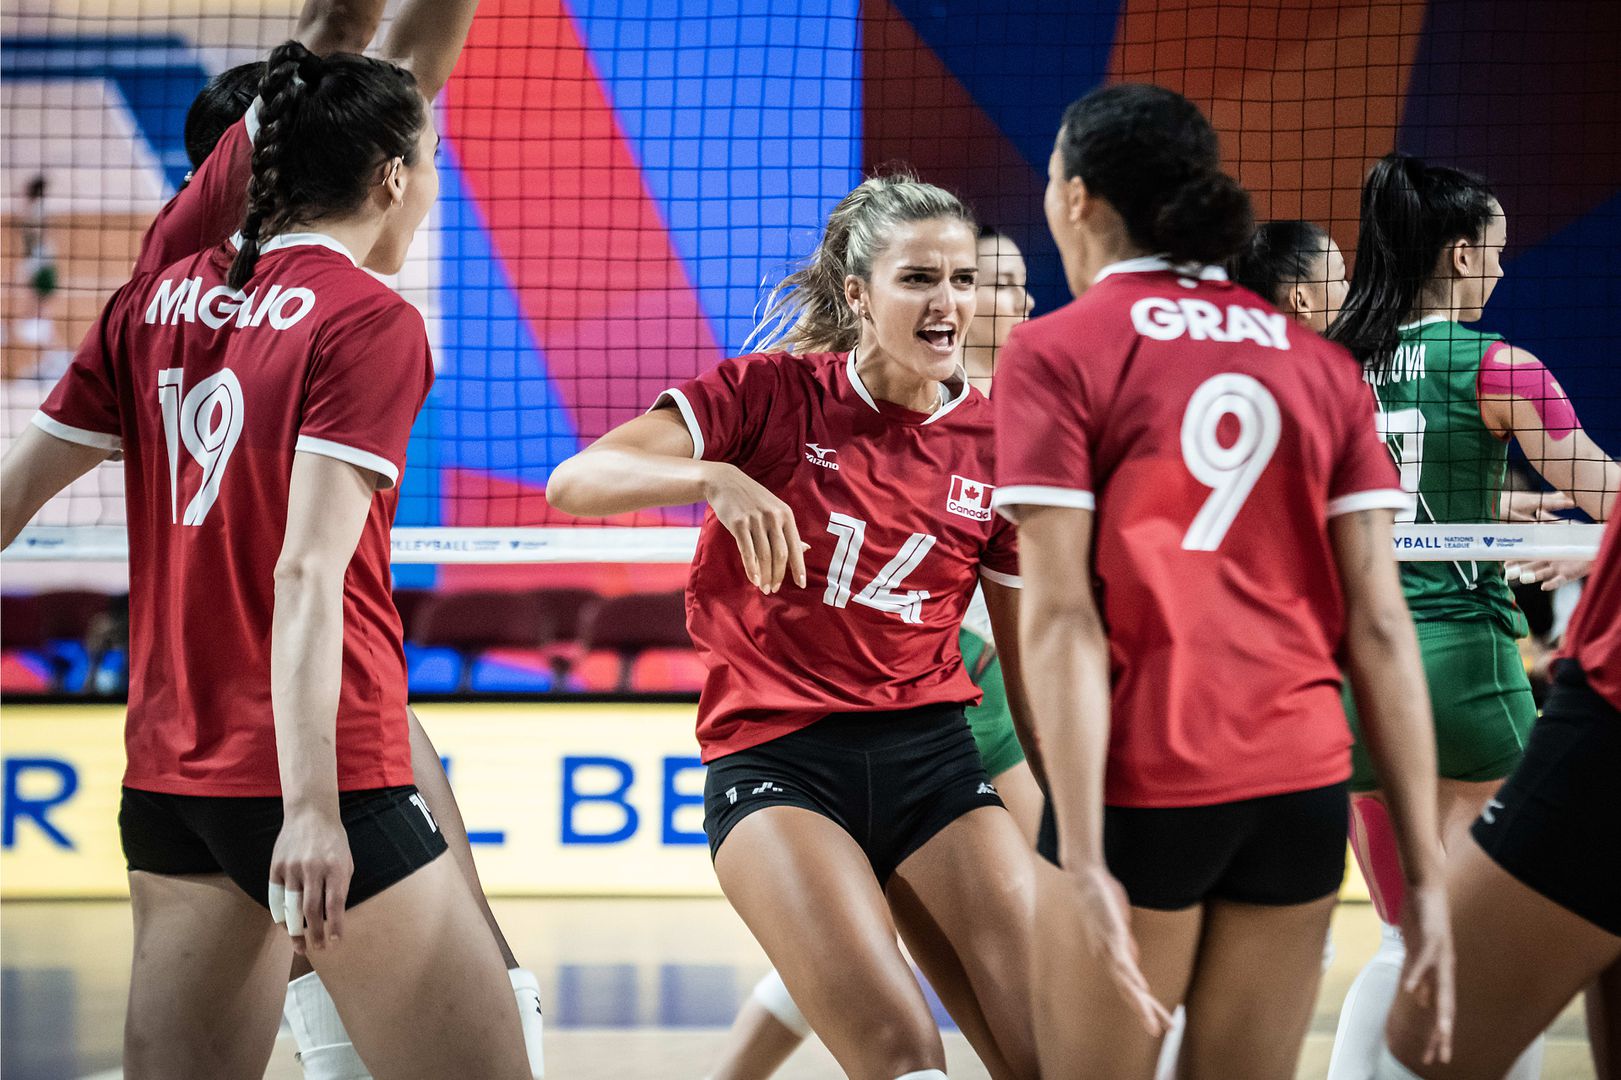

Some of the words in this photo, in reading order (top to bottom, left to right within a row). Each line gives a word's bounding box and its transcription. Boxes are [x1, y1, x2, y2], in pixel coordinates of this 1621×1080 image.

[1131, 297, 1291, 350] GRAY
[158, 367, 245, 527] 19
[1180, 372, 1282, 552] 9
[948, 501, 989, 519] Canada
[1393, 537, 1442, 549] YBALL
[822, 511, 937, 624] 14
